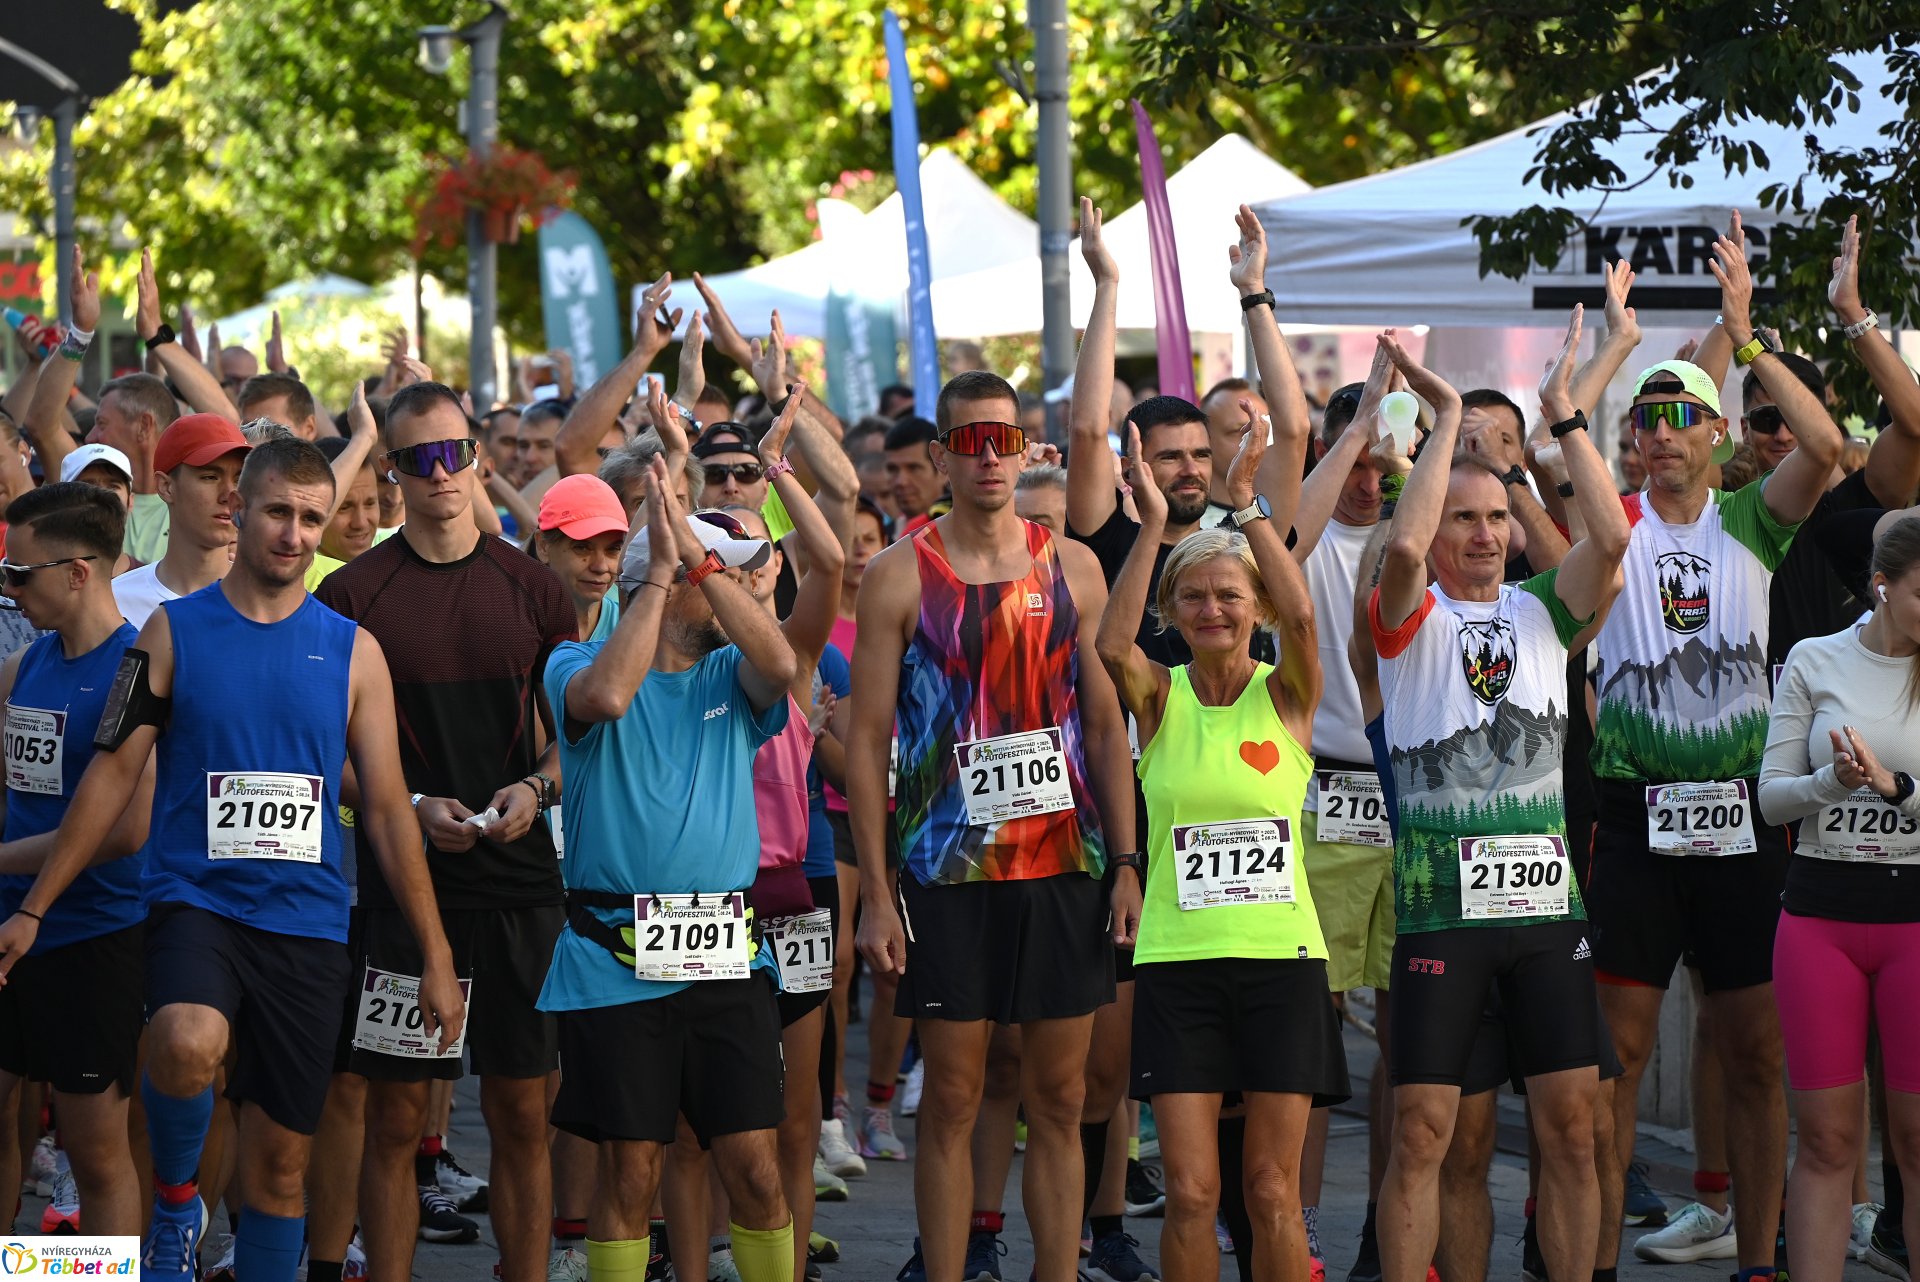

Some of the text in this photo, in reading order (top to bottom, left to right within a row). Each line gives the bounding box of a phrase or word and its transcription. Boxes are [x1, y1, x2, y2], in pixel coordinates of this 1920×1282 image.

[5, 732, 57, 765] 21053
[984, 747, 1037, 761] FUTÓFESZTIVÁL
[970, 756, 1061, 796] 21106
[236, 787, 294, 797] FUTÓFESZTIVÁL
[1672, 793, 1724, 803] FUTÓFESZTIVÁL
[217, 801, 316, 831] 21097
[1657, 804, 1744, 832] 21200
[1825, 807, 1917, 835] 21203
[1201, 835, 1259, 846] FUTÓFESZTIVÁL
[1487, 849, 1540, 858] FUTÓFESZTIVÁL
[1185, 847, 1285, 880] 21124
[1471, 861, 1563, 890] 21300
[663, 909, 717, 918] FUTÓFESZTIVÁL
[645, 923, 735, 951] 21091
[785, 937, 831, 967] 211
[1408, 957, 1446, 976] STB
[387, 989, 419, 1000] FUTÓFES
[366, 998, 424, 1030] 210
